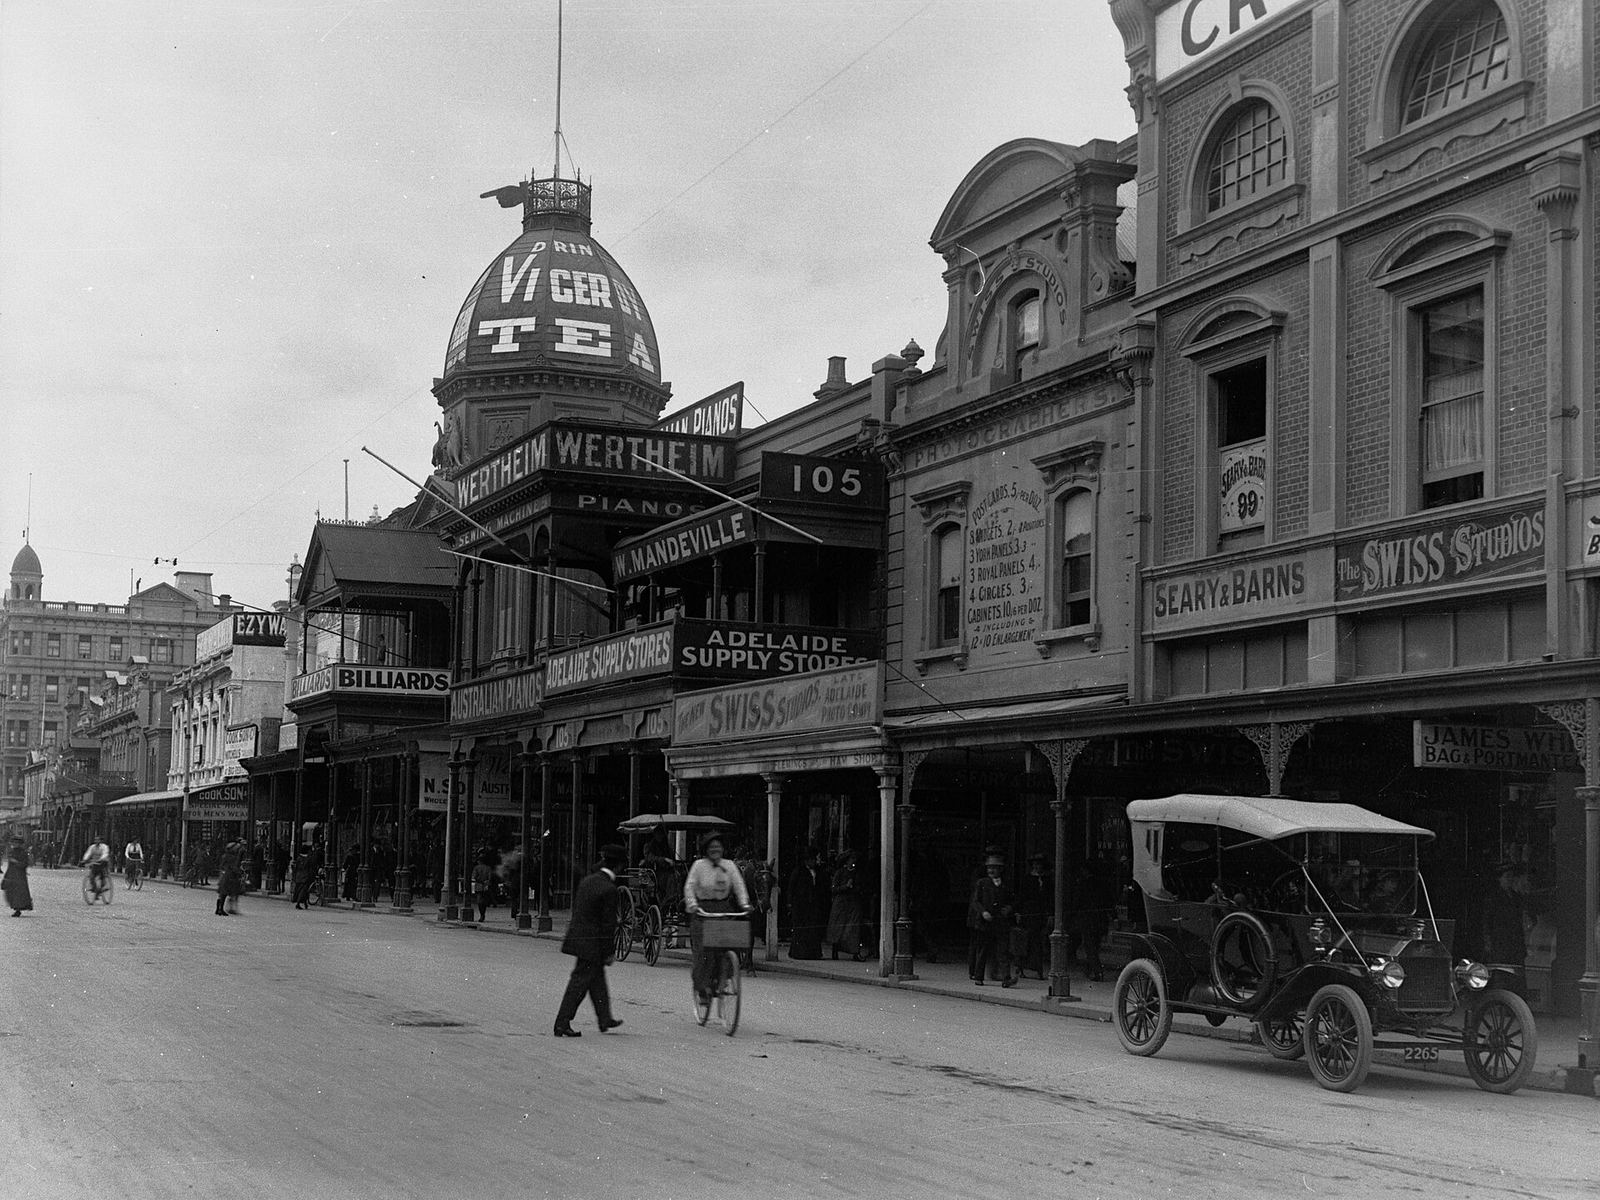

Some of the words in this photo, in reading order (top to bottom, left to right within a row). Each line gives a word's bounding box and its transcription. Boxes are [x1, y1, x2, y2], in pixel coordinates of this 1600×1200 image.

[1026, 257, 1065, 326] STUDIOS
[694, 394, 737, 436] PIANOS
[458, 433, 547, 508] WERTHEIM
[556, 431, 725, 478] WERTHEIM
[793, 465, 861, 496] 105
[1238, 490, 1258, 520] 99
[632, 512, 746, 573] MANDEVILLE
[1338, 557, 1361, 582] The
[1362, 531, 1446, 592] SWISS
[1450, 509, 1545, 574] STUDIOS
[970, 568, 974, 583] 3
[978, 565, 997, 581] ROYAL
[1155, 575, 1220, 617] SEARY
[1220, 584, 1229, 607] &
[1232, 561, 1305, 605] BARNS
[681, 647, 773, 670] SUPPLY
[707, 630, 847, 653] ADELAIDE
[546, 651, 590, 689] ADELAIDE
[591, 641, 628, 679] SUPPLY
[626, 631, 670, 671] STORES
[292, 669, 331, 698] BILLIARDS
[338, 669, 449, 691] BILLIARDS
[450, 679, 504, 720] AUSTRALIAN
[505, 672, 542, 711] PIANOS
[709, 689, 775, 737] SWISS
[1424, 725, 1510, 749] JAMES
[1425, 746, 1460, 764] BAG
[1405, 1047, 1438, 1060] 2265
